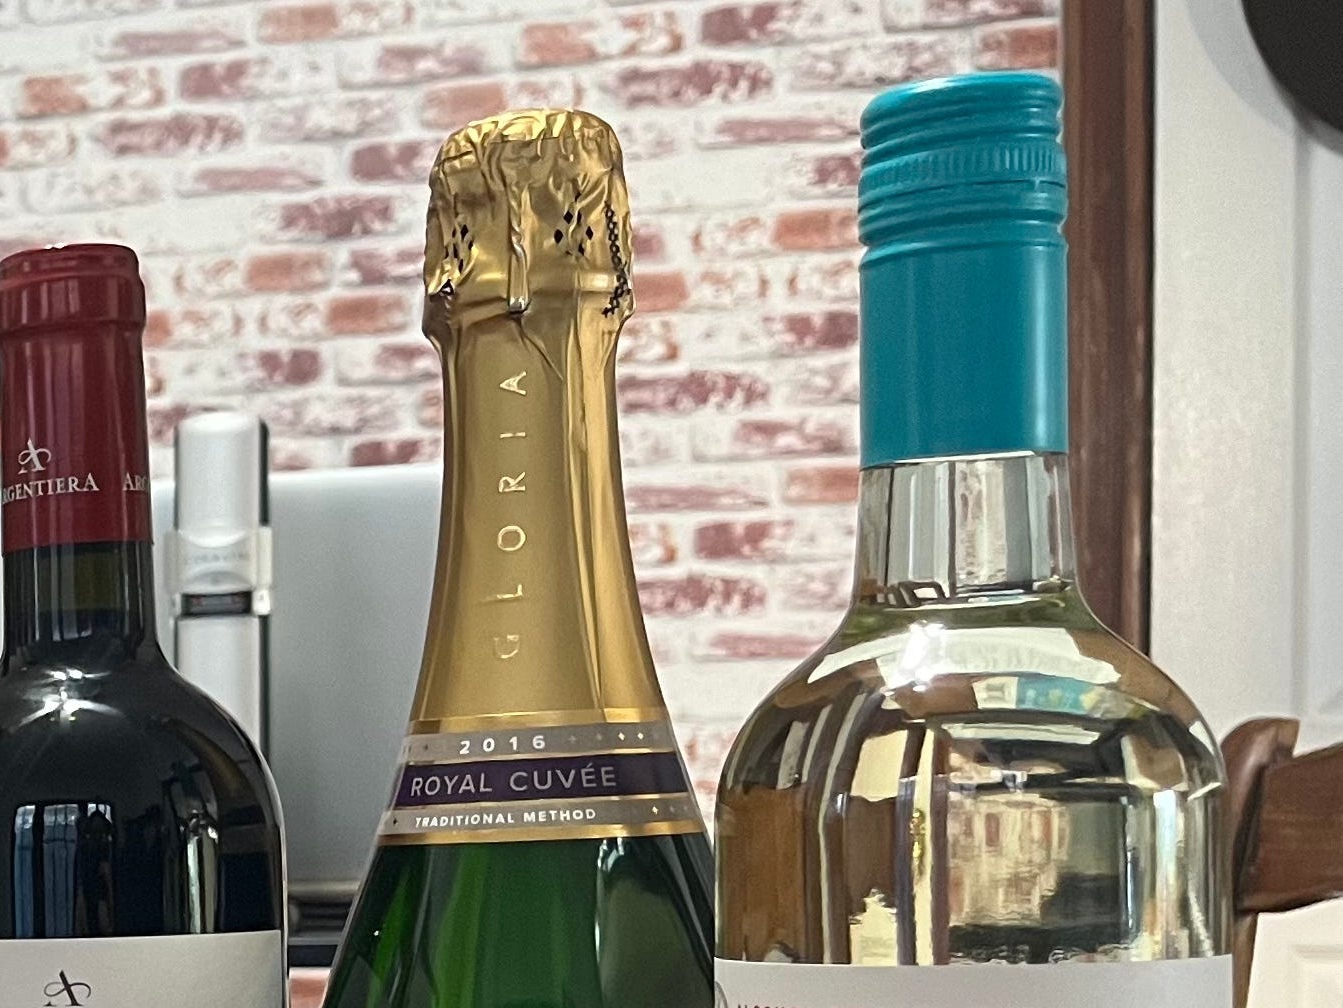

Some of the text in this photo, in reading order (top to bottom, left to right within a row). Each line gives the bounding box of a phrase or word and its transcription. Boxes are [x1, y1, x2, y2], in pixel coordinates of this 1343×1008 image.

[493, 368, 528, 660] GLORIA
[459, 734, 547, 755] 2016
[411, 762, 617, 797] ROYAL CUVÉE
[415, 808, 597, 829] TRADITIONAL METHOD
